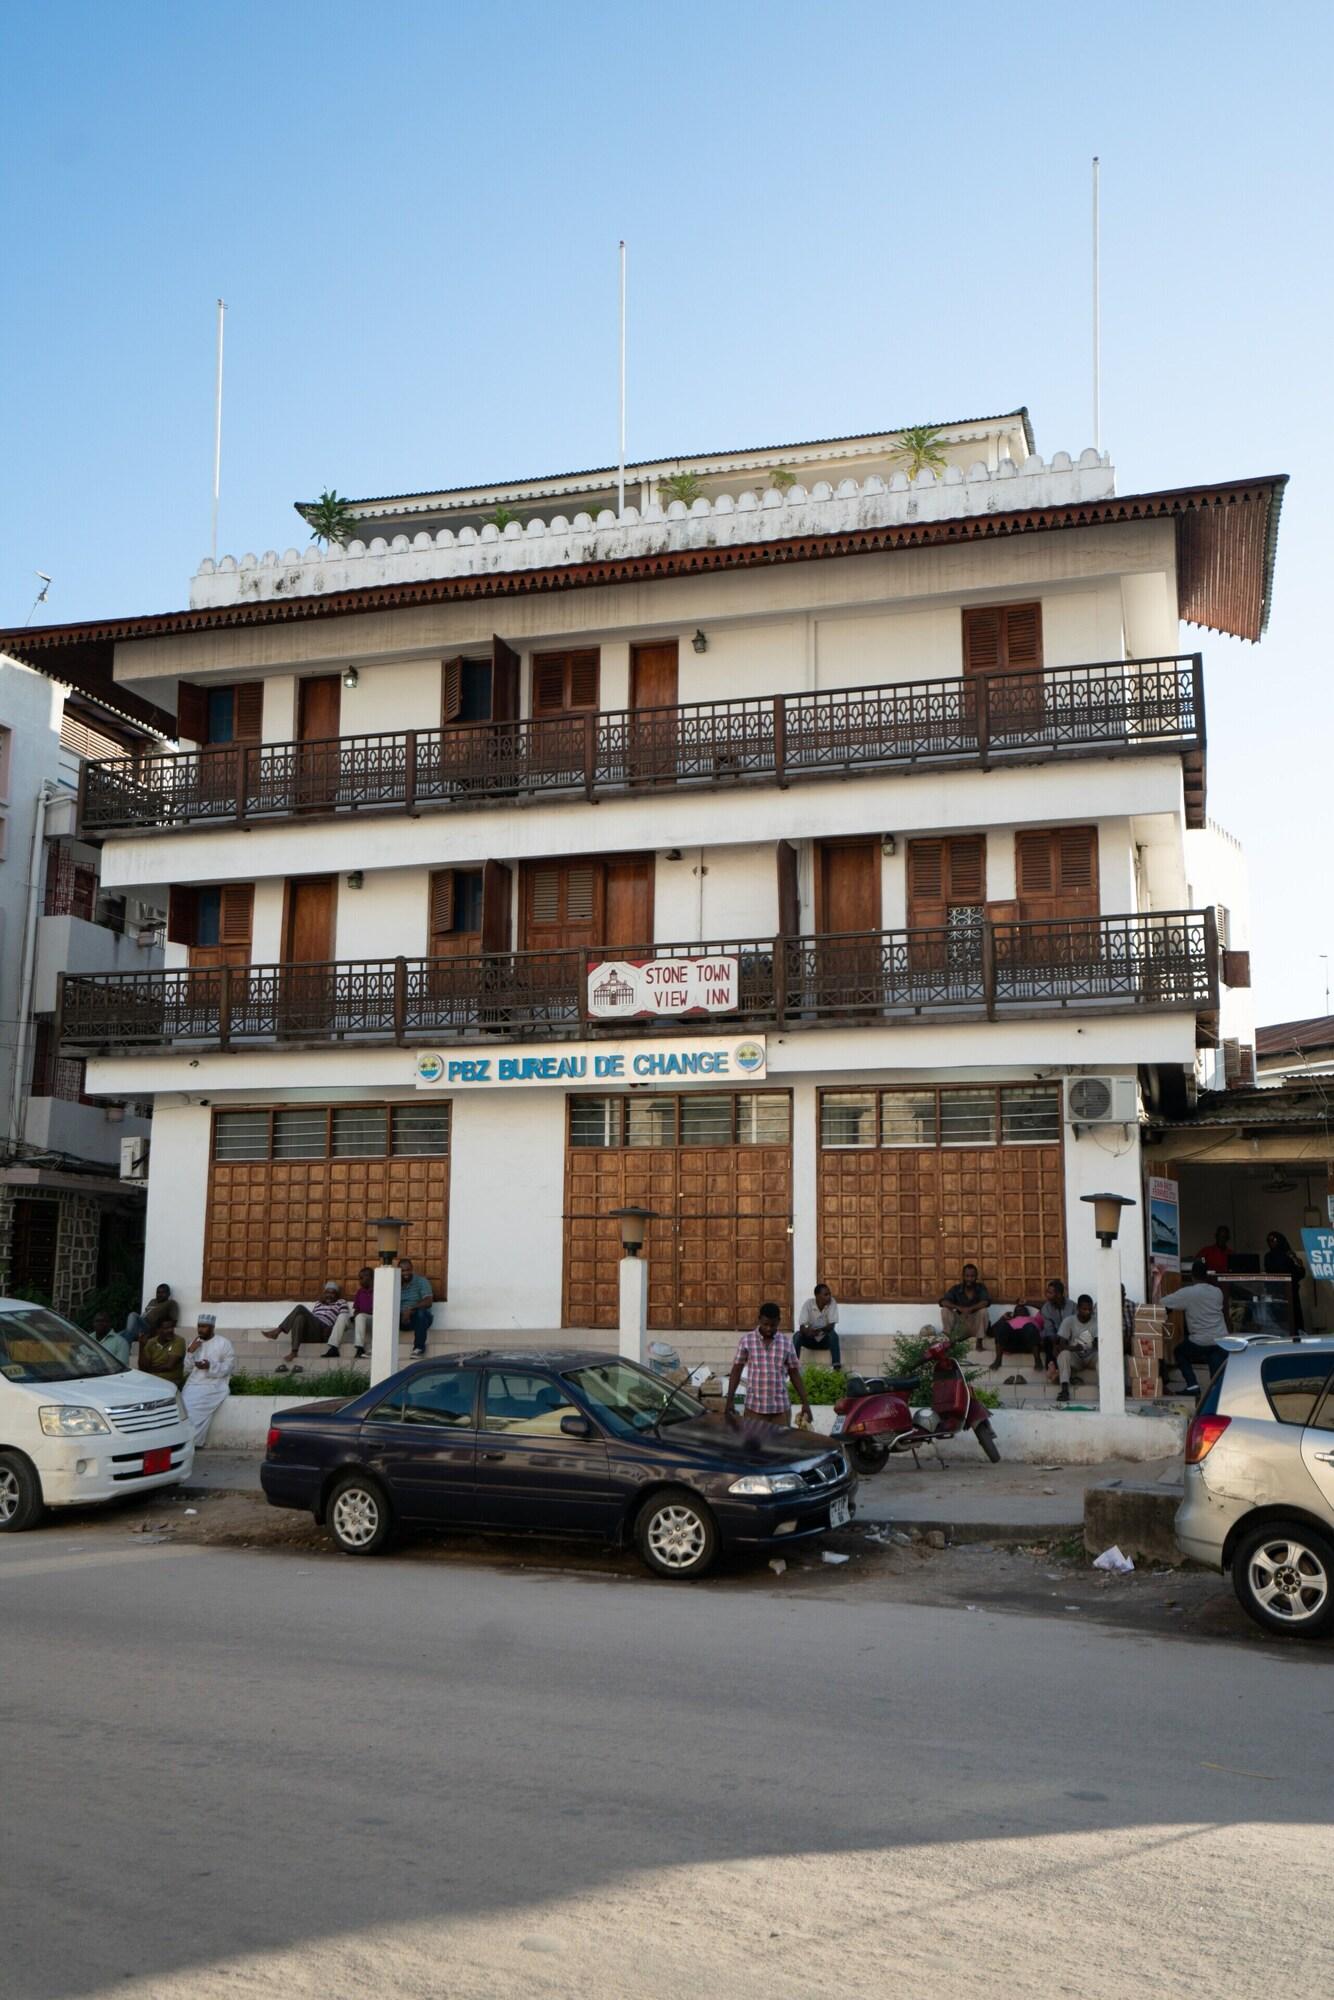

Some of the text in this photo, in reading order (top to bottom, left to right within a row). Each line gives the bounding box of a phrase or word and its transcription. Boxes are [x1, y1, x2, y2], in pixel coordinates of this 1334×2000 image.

[645, 963, 731, 985] STONE TOWN
[654, 988, 730, 1008] VIEW INN
[448, 1051, 729, 1082] PBZ BUREAU DE CHANGE
[1311, 1250, 1334, 1263] ST
[1311, 1263, 1334, 1278] MA
